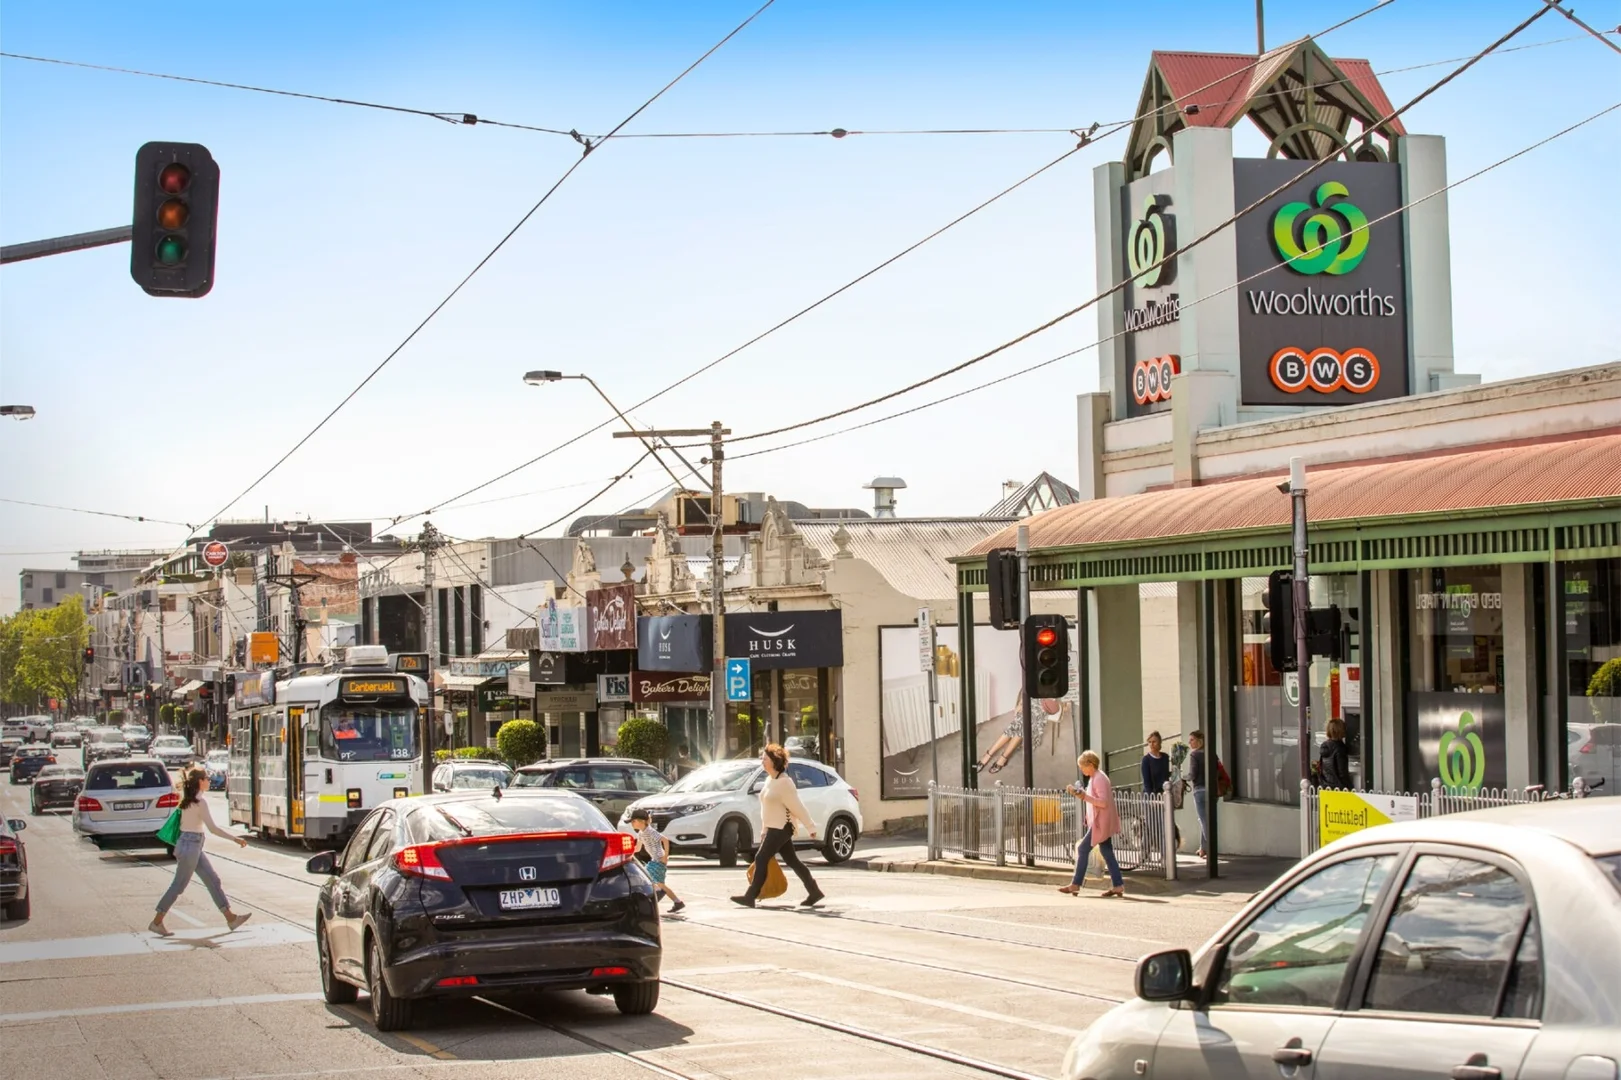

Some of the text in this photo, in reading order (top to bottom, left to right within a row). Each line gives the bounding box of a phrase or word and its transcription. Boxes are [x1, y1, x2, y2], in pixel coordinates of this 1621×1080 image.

[1250, 287, 1395, 316] Woolworths
[1124, 298, 1180, 332] Woolworths
[1286, 361, 1365, 379] BWS
[749, 639, 796, 651] HUSK
[349, 681, 396, 692] Camberwell
[640, 680, 711, 698] Bakers Deligh
[730, 676, 746, 696] P
[392, 748, 408, 758] 138
[1325, 804, 1367, 829] [untitled]
[501, 888, 559, 905] ZHP 110
